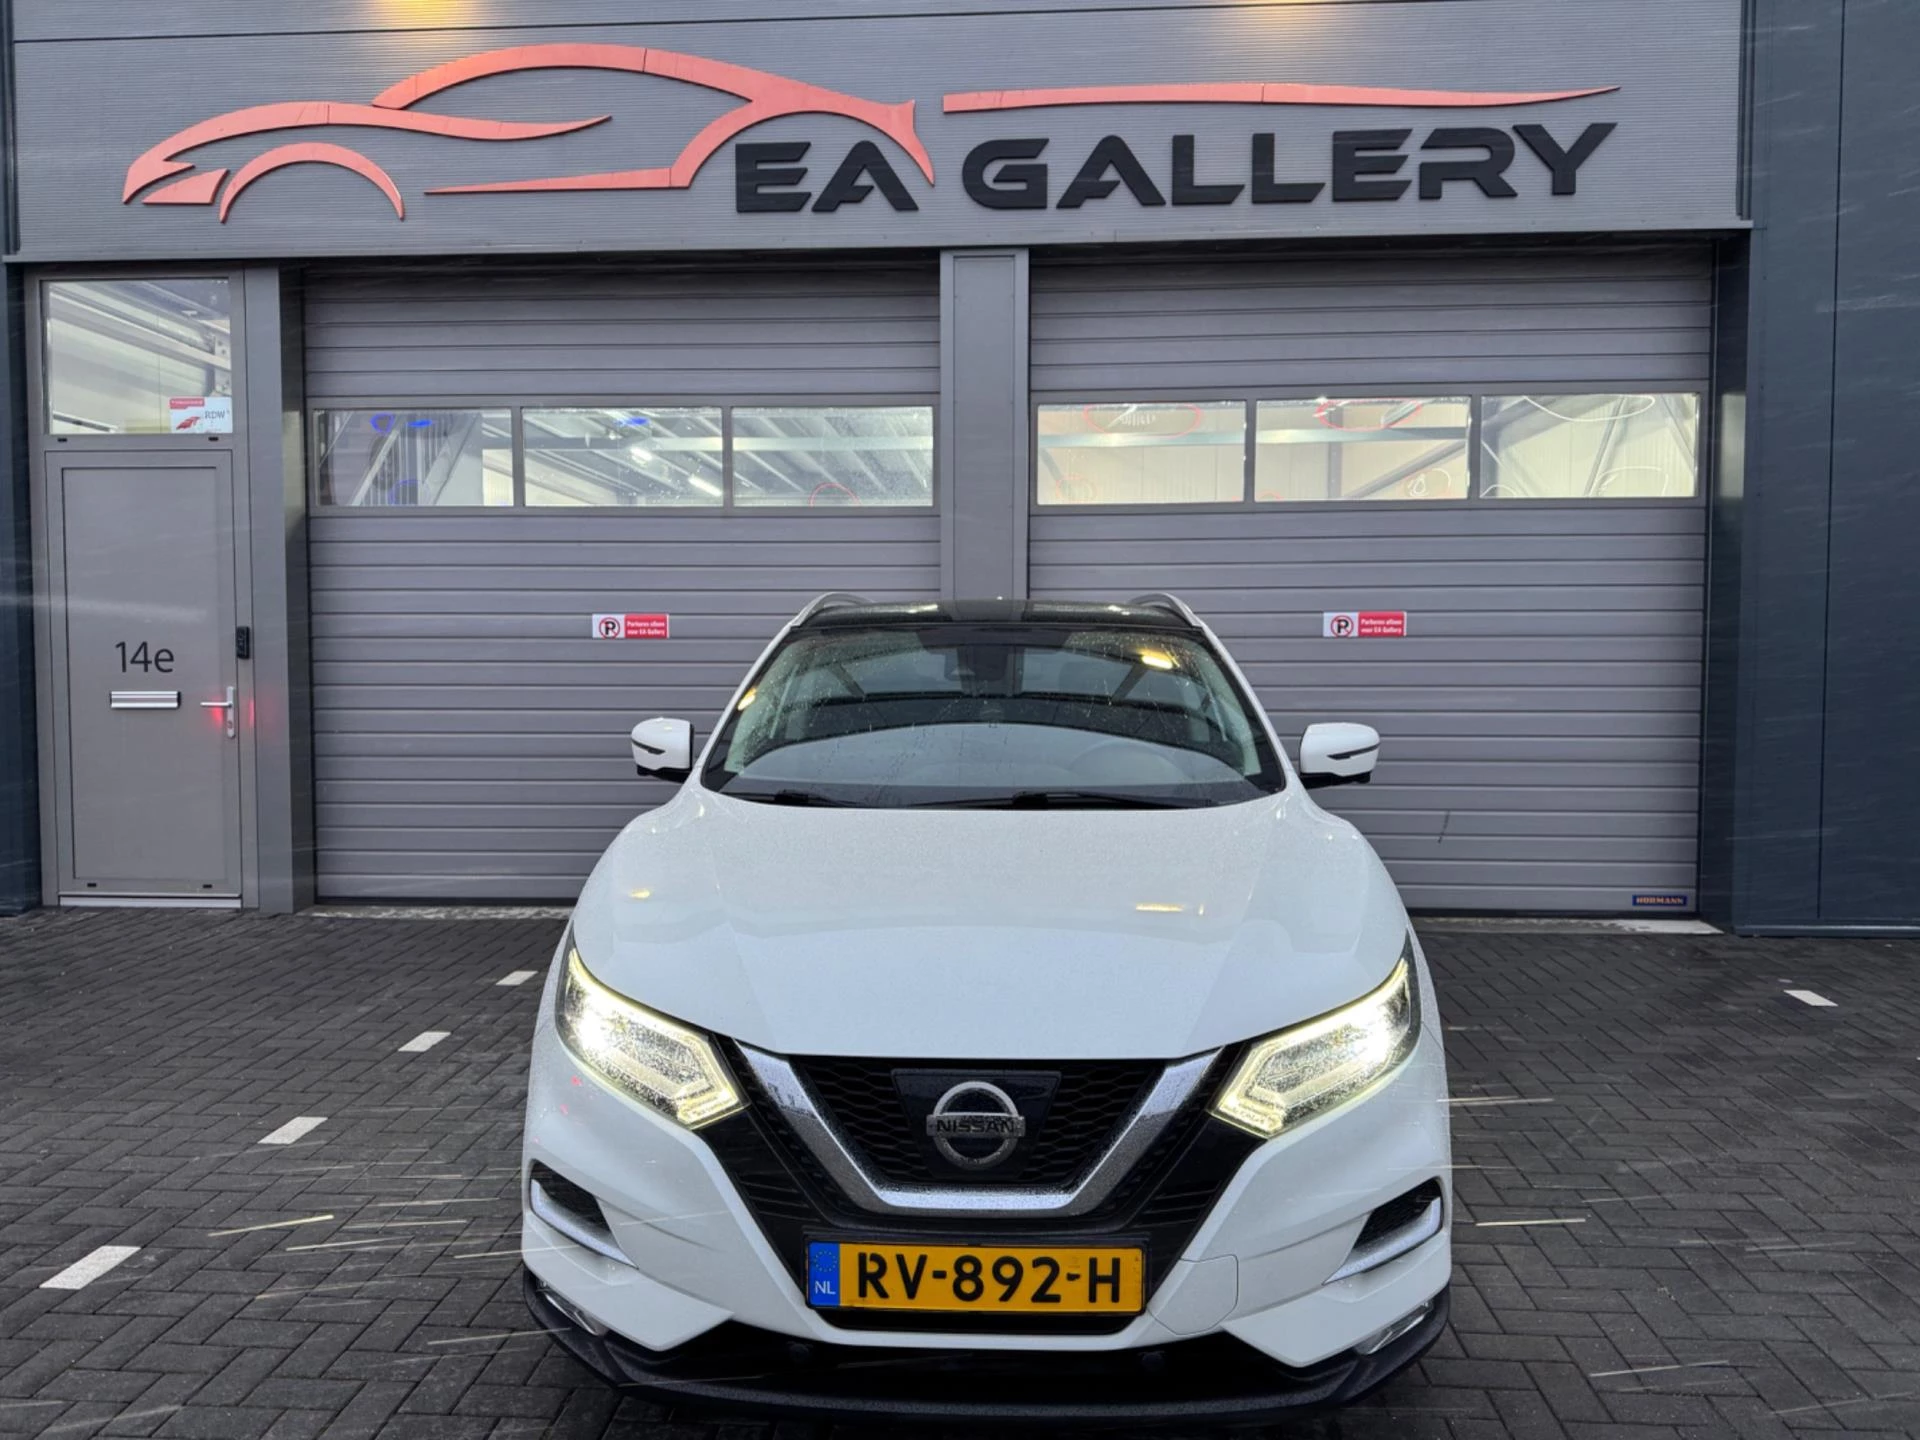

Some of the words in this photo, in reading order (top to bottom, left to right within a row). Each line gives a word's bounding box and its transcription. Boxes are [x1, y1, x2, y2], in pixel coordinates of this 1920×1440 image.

[735, 139, 919, 213] EA
[962, 122, 1618, 211] GALLERY
[115, 640, 175, 673] 14e
[936, 1119, 1015, 1133] NISSAN
[814, 1280, 837, 1295] NL
[858, 1252, 1121, 1304] RV-892-H
